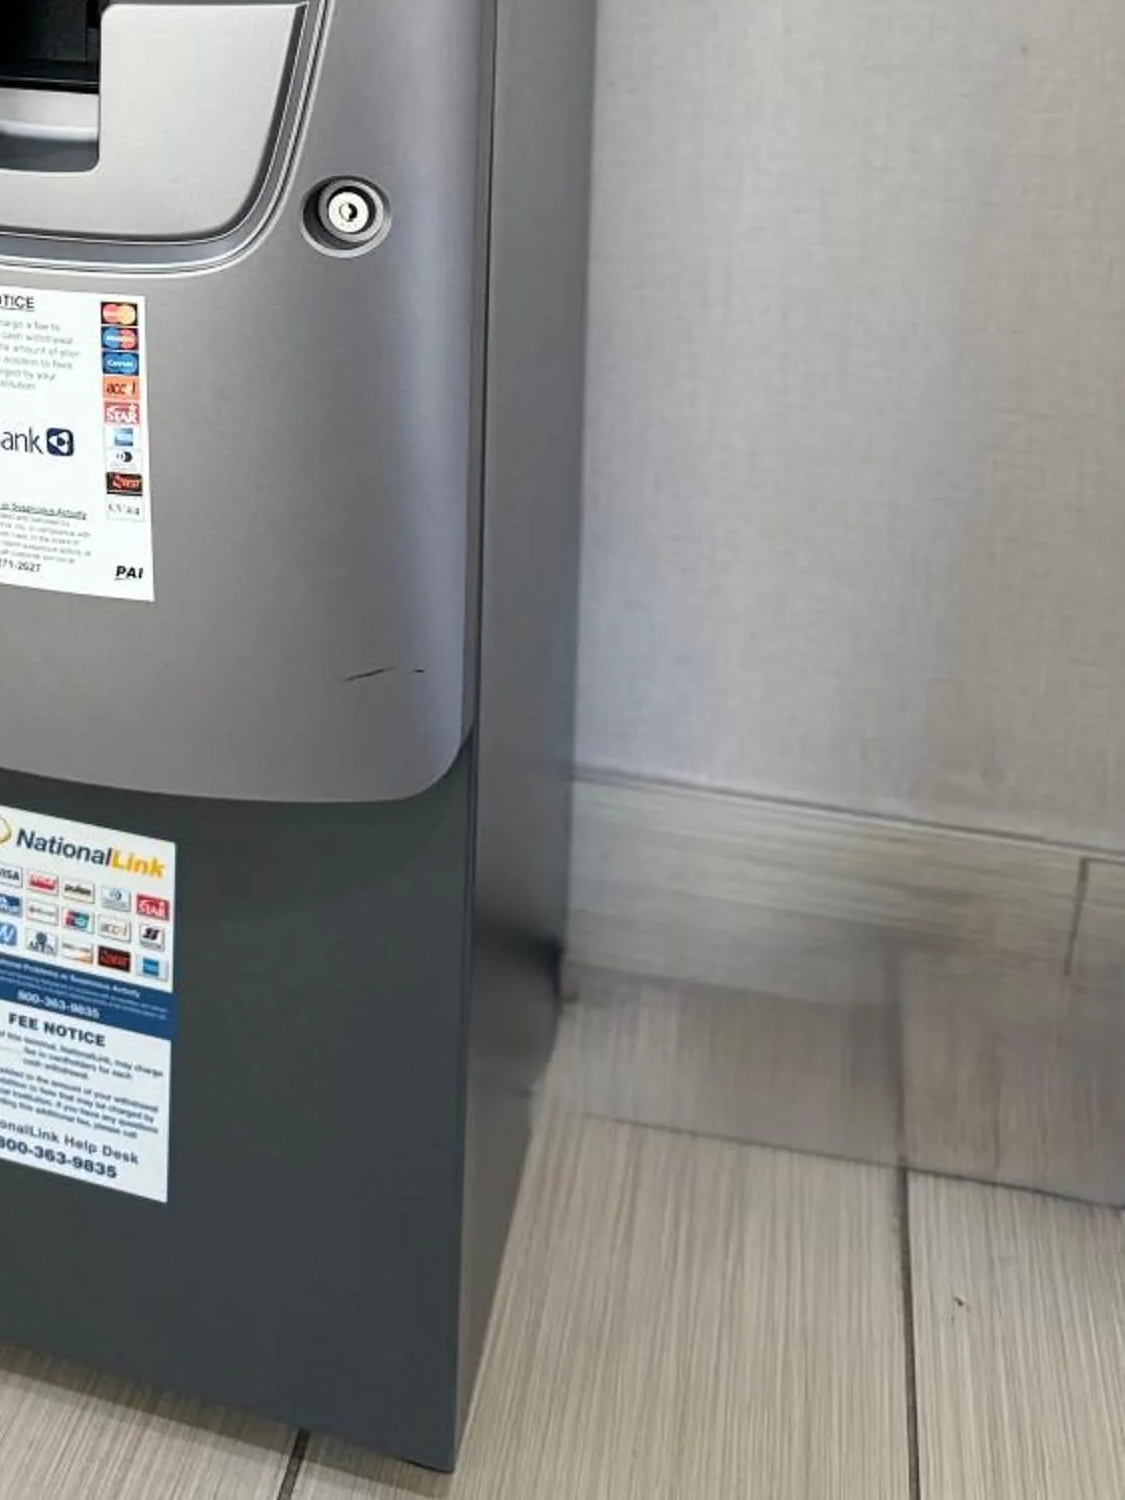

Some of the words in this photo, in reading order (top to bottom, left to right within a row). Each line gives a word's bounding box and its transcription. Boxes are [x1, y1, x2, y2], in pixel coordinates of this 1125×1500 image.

[115, 565, 144, 580] PAI
[16, 827, 165, 878] NationalLink
[7, 1012, 39, 1032] FEE
[43, 1020, 107, 1047] NOTICE
[63, 1133, 98, 1156] Help
[101, 1142, 139, 1165] Desk
